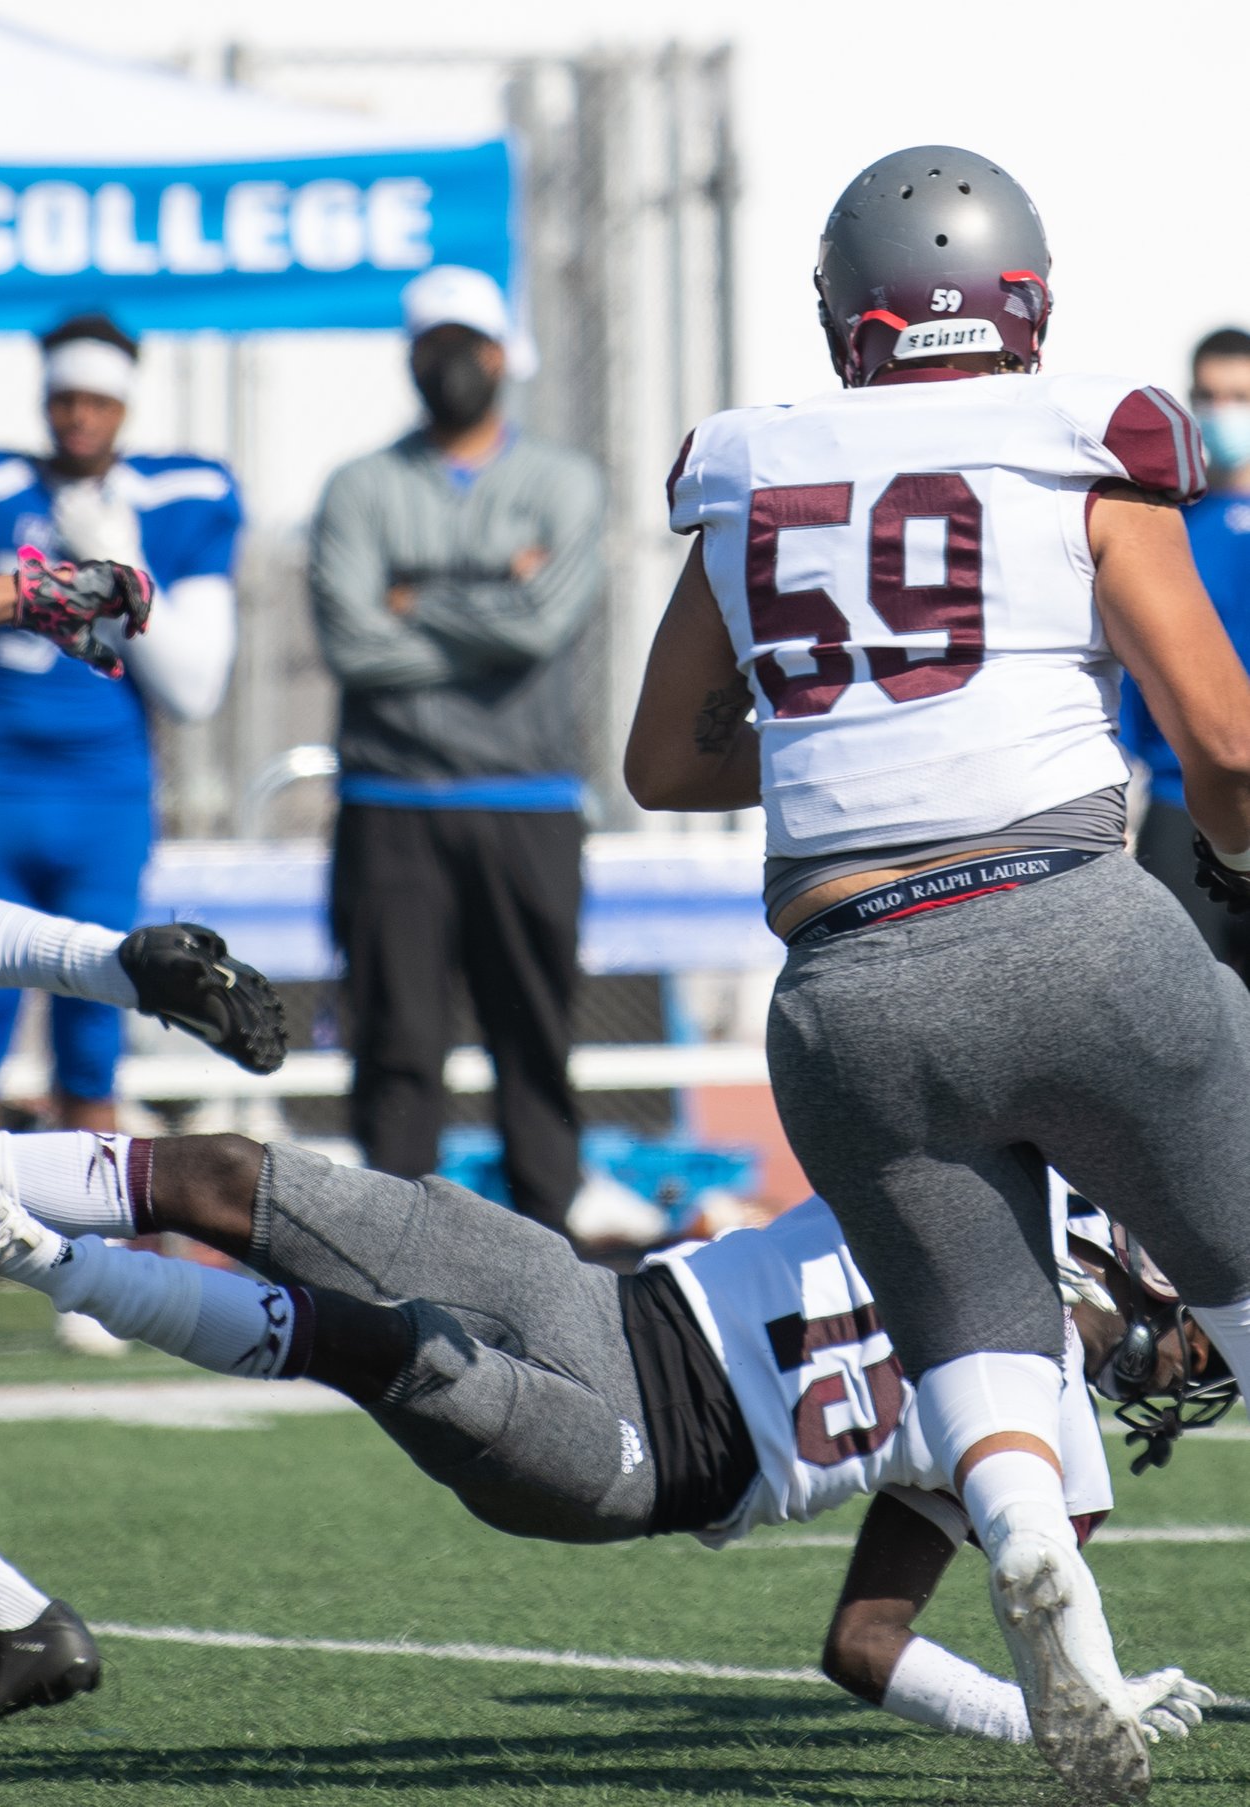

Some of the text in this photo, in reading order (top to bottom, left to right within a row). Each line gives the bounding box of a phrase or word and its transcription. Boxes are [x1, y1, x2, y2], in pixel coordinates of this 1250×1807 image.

[930, 288, 963, 314] 59
[907, 326, 988, 349] schutt
[745, 472, 984, 720] 59
[857, 858, 1051, 918] POLO RALPH LAUREN
